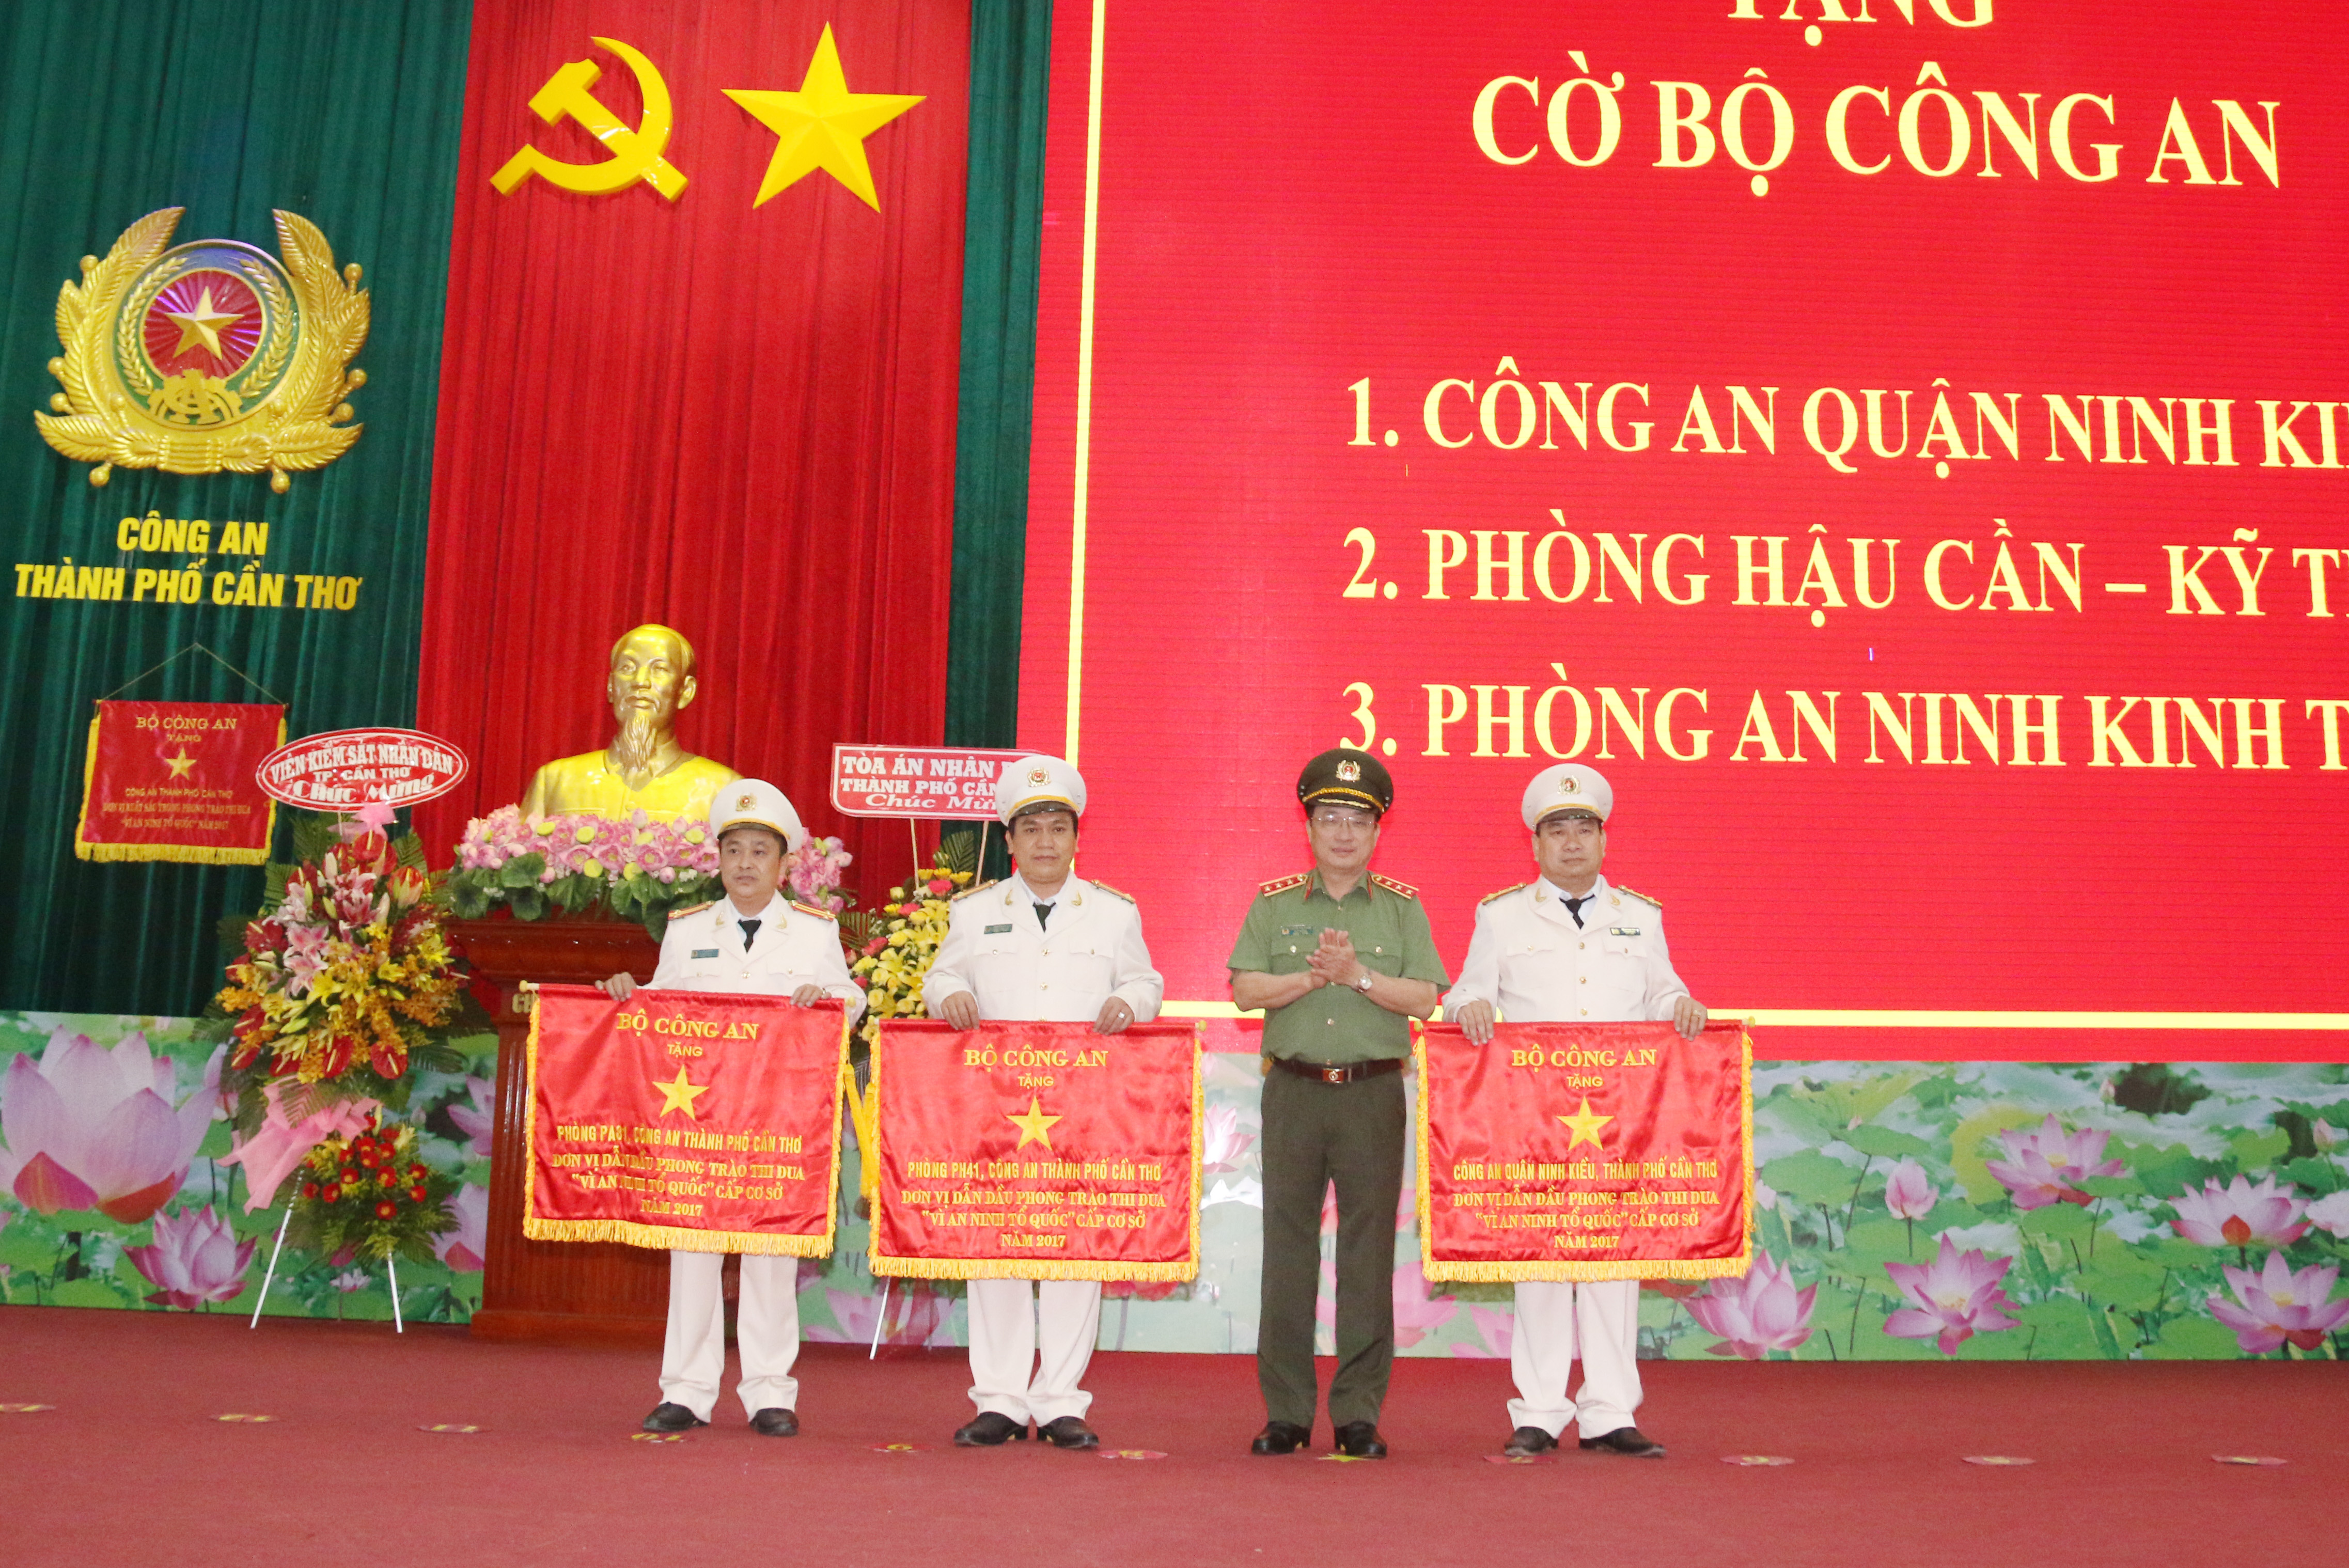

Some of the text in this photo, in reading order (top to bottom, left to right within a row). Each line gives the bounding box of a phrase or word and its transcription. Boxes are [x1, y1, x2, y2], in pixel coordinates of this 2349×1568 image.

[1473, 51, 2280, 197] CỜ BỘ CÔNG AN
[1348, 356, 2349, 478] 1. CÔNG AN QUẬN NINH KI
[116, 510, 269, 555] CÔNG AN
[1343, 527, 1398, 599] 2.
[1422, 509, 1710, 605] PHÒNG
[1730, 524, 1900, 627] HẬU
[1924, 519, 2084, 613] CẦN
[2163, 528, 2273, 615] KỸ
[15, 556, 363, 610] THÀNH PHỐ CẦN THƠ
[136, 714, 237, 731] BỘ CÔNG AN
[1340, 682, 1397, 756] 3.
[1421, 663, 1713, 761] PHÒNG
[1730, 689, 1840, 763] AN
[1862, 692, 2066, 766] NINH
[2084, 696, 2290, 769] KINH
[271, 739, 453, 785] VIỆN KIỂM SÁT NHÂN DÂN
[341, 765, 376, 780] CẦN
[380, 766, 411, 778] THƠ
[842, 751, 886, 774] TÒA
[891, 754, 924, 775] ÁN
[930, 756, 995, 778] NHÂN
[293, 772, 434, 803] Chúc Mừng
[841, 775, 910, 793] THÀNH
[915, 777, 958, 795] PHỐ
[865, 794, 936, 808] Chúc
[616, 1008, 759, 1039] BỘ CÔNG AN
[667, 1042, 703, 1058] TẶNG
[964, 1043, 1108, 1072] BỘ CÔNG AN
[1511, 1043, 1657, 1072] BỘ CÔNG AN
[1017, 1073, 1054, 1089] TẶNG
[1567, 1073, 1603, 1089] TẶNG
[557, 1121, 597, 1141] PHÒNG
[664, 1130, 680, 1147] AN
[683, 1127, 723, 1151] THÀNH
[726, 1128, 753, 1152] PHỐ
[753, 1130, 776, 1152] CẦN
[779, 1135, 802, 1154] THƠ
[584, 1154, 600, 1171] VỊ
[602, 1145, 630, 1168] DẪN
[655, 1157, 704, 1174] PHONG
[709, 1159, 748, 1178] TRÀO
[750, 1165, 774, 1178] THI
[907, 1157, 947, 1178] PHÒNG
[988, 1158, 1019, 1179] CÔNG
[1023, 1162, 1038, 1179] AN
[1041, 1157, 1080, 1179] THÀNH
[1085, 1157, 1109, 1180] PHỐ
[1111, 1157, 1135, 1180] CẦN
[1138, 1163, 1162, 1181] THƠ
[1453, 1155, 1718, 1184] CÔNG AN QUẬN NINH KIỀU, THÀNH PHỐ CẦN THƠ
[597, 1175, 617, 1188] AN
[648, 1171, 666, 1193] TỔ
[715, 1179, 744, 1199] CẤP
[745, 1186, 764, 1200] CƠ
[765, 1182, 783, 1200] SỞ
[901, 1183, 1167, 1209] ĐƠN VỊ DẪN ĐẦU PHONG TRÀO THI ĐUA
[1453, 1191, 1484, 1207] ĐƠN
[1486, 1193, 1501, 1211] VỊ
[1504, 1184, 1533, 1206] DẪN
[1536, 1184, 1565, 1205] ĐẦU
[1568, 1191, 1618, 1205] PHONG
[1620, 1187, 1659, 1205] TRÀO
[1662, 1191, 1688, 1205] THI
[640, 1196, 703, 1216] NĂM 2017
[947, 1213, 967, 1226] AN
[970, 1213, 1005, 1227] NINH
[1008, 1205, 1027, 1226] TỔ
[1076, 1206, 1104, 1227] CẤP
[1106, 1214, 1125, 1228] CƠ
[1128, 1210, 1146, 1228] SỞ
[1499, 1214, 1518, 1228] AN
[1522, 1214, 1557, 1228] NINH
[1560, 1206, 1580, 1227] TỔ
[1629, 1206, 1657, 1227] CẤP
[1659, 1212, 1679, 1227] CƠ
[1681, 1207, 1699, 1227] SỞ
[1001, 1230, 1066, 1247] NĂM 2017
[1554, 1231, 1619, 1248] NĂM 2017
